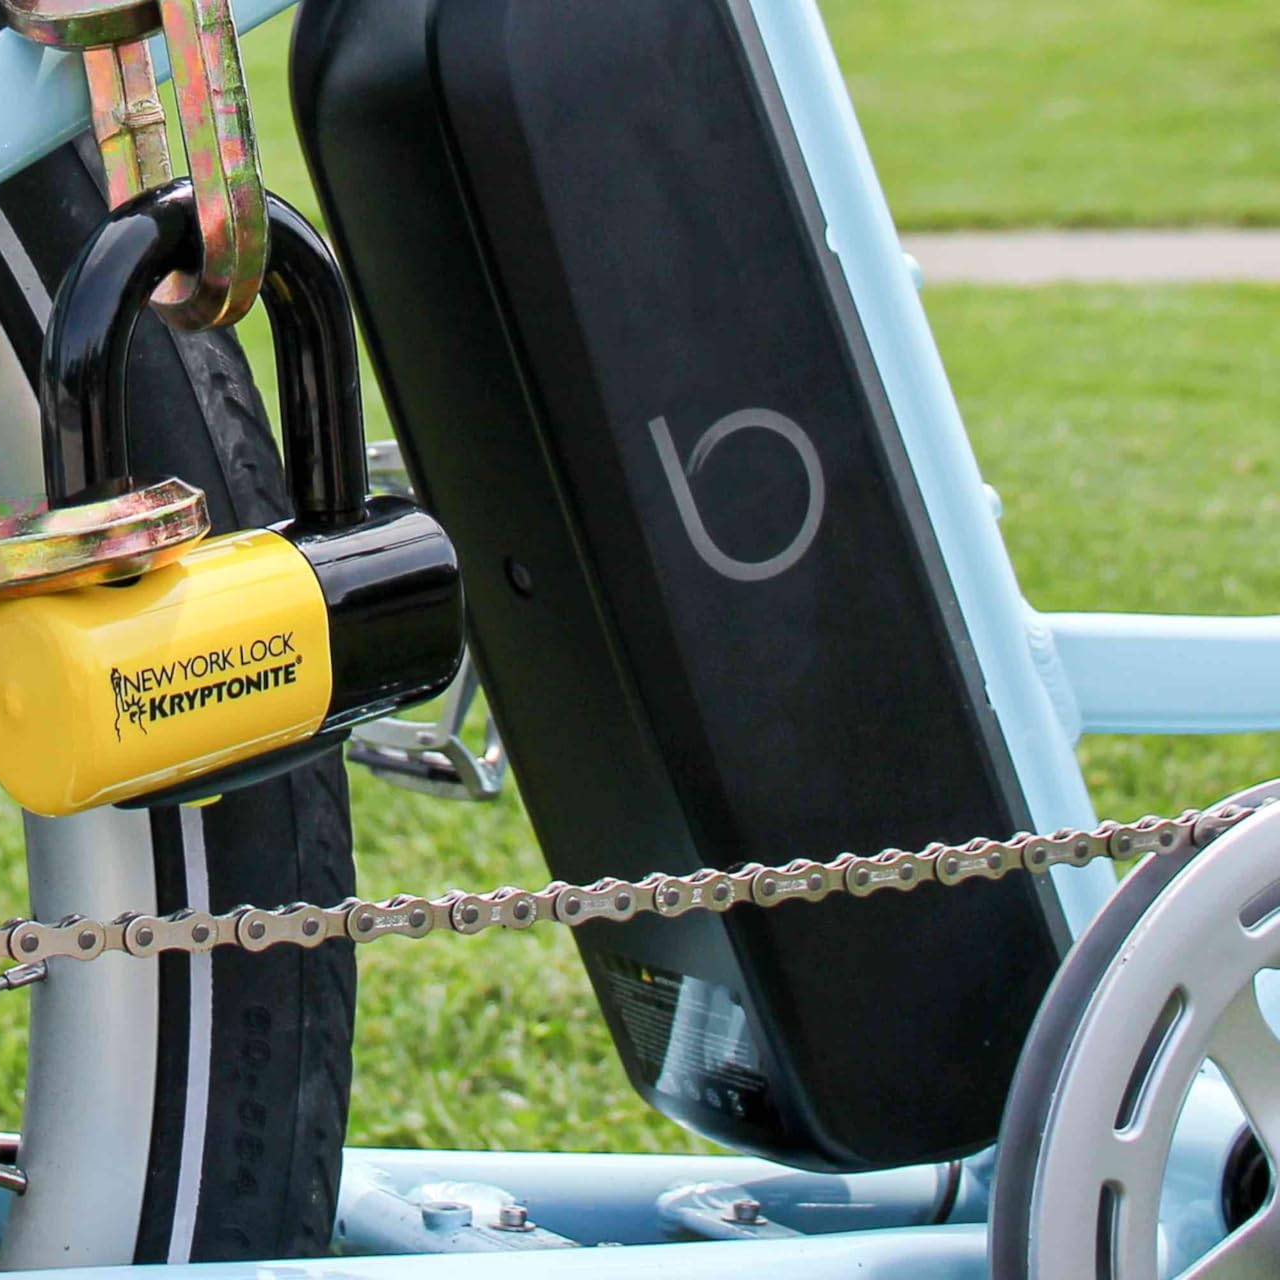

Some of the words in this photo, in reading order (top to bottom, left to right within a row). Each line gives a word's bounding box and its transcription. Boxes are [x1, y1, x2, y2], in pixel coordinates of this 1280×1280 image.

[123, 662, 176, 696] NEW
[177, 647, 235, 680] YORK
[240, 631, 296, 666] LOCK
[149, 662, 297, 721] KRYPTONITE
